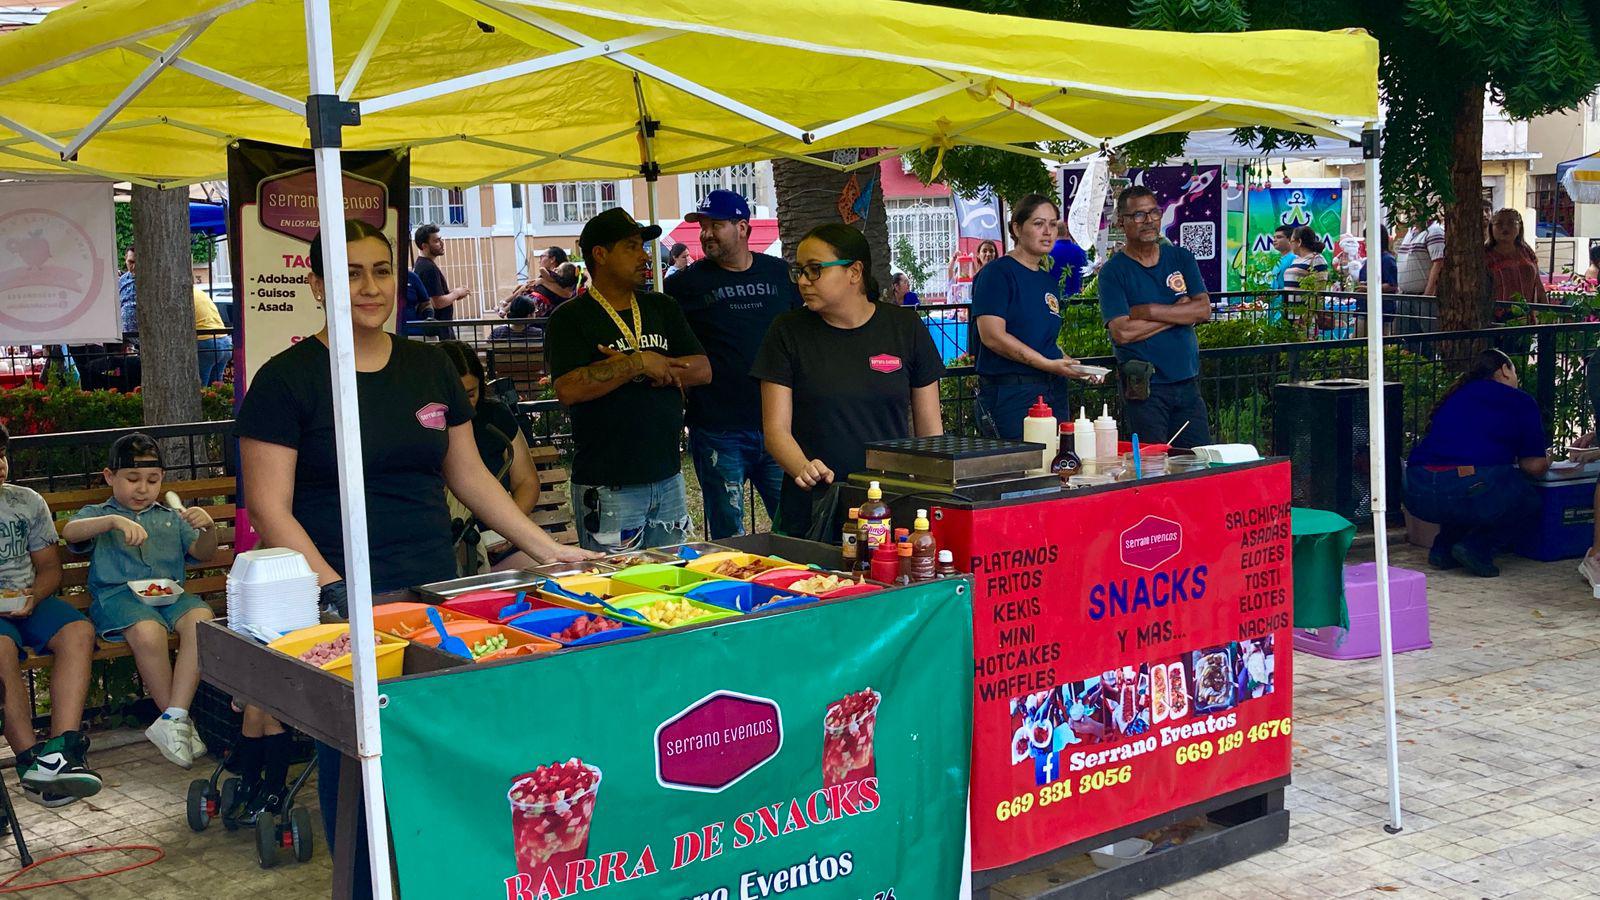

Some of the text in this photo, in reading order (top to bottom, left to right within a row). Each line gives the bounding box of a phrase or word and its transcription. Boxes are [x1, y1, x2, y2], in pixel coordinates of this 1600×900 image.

[343, 196, 380, 210] entos
[280, 219, 291, 227] EN
[291, 220, 305, 228] LOS
[257, 288, 296, 298] Guisos
[257, 302, 294, 312] Asada
[1225, 501, 1291, 531] SALCHICHA
[1240, 522, 1289, 549] ASADAS
[969, 544, 1059, 574] PLATANOS
[1241, 544, 1285, 570] ELOTES
[987, 569, 1043, 598] FRITOS
[1088, 564, 1208, 620] SNACKS
[1245, 568, 1281, 591] TOSTI
[993, 596, 1041, 624] KEKIS
[1240, 588, 1286, 613] ELOTES
[1000, 624, 1035, 649] MINI
[1238, 611, 1289, 639] NACHOS
[1117, 628, 1128, 653] Y
[973, 642, 1061, 677] HOTCAKES
[979, 668, 1056, 702] WAFFLES
[1069, 712, 1237, 772] Serrano Eventos
[1175, 717, 1291, 766] 669 189 4676
[996, 765, 1132, 822] 669 331 3056
[504, 777, 881, 900] BARRA DE SNACKS
[739, 851, 854, 900] Eventos
